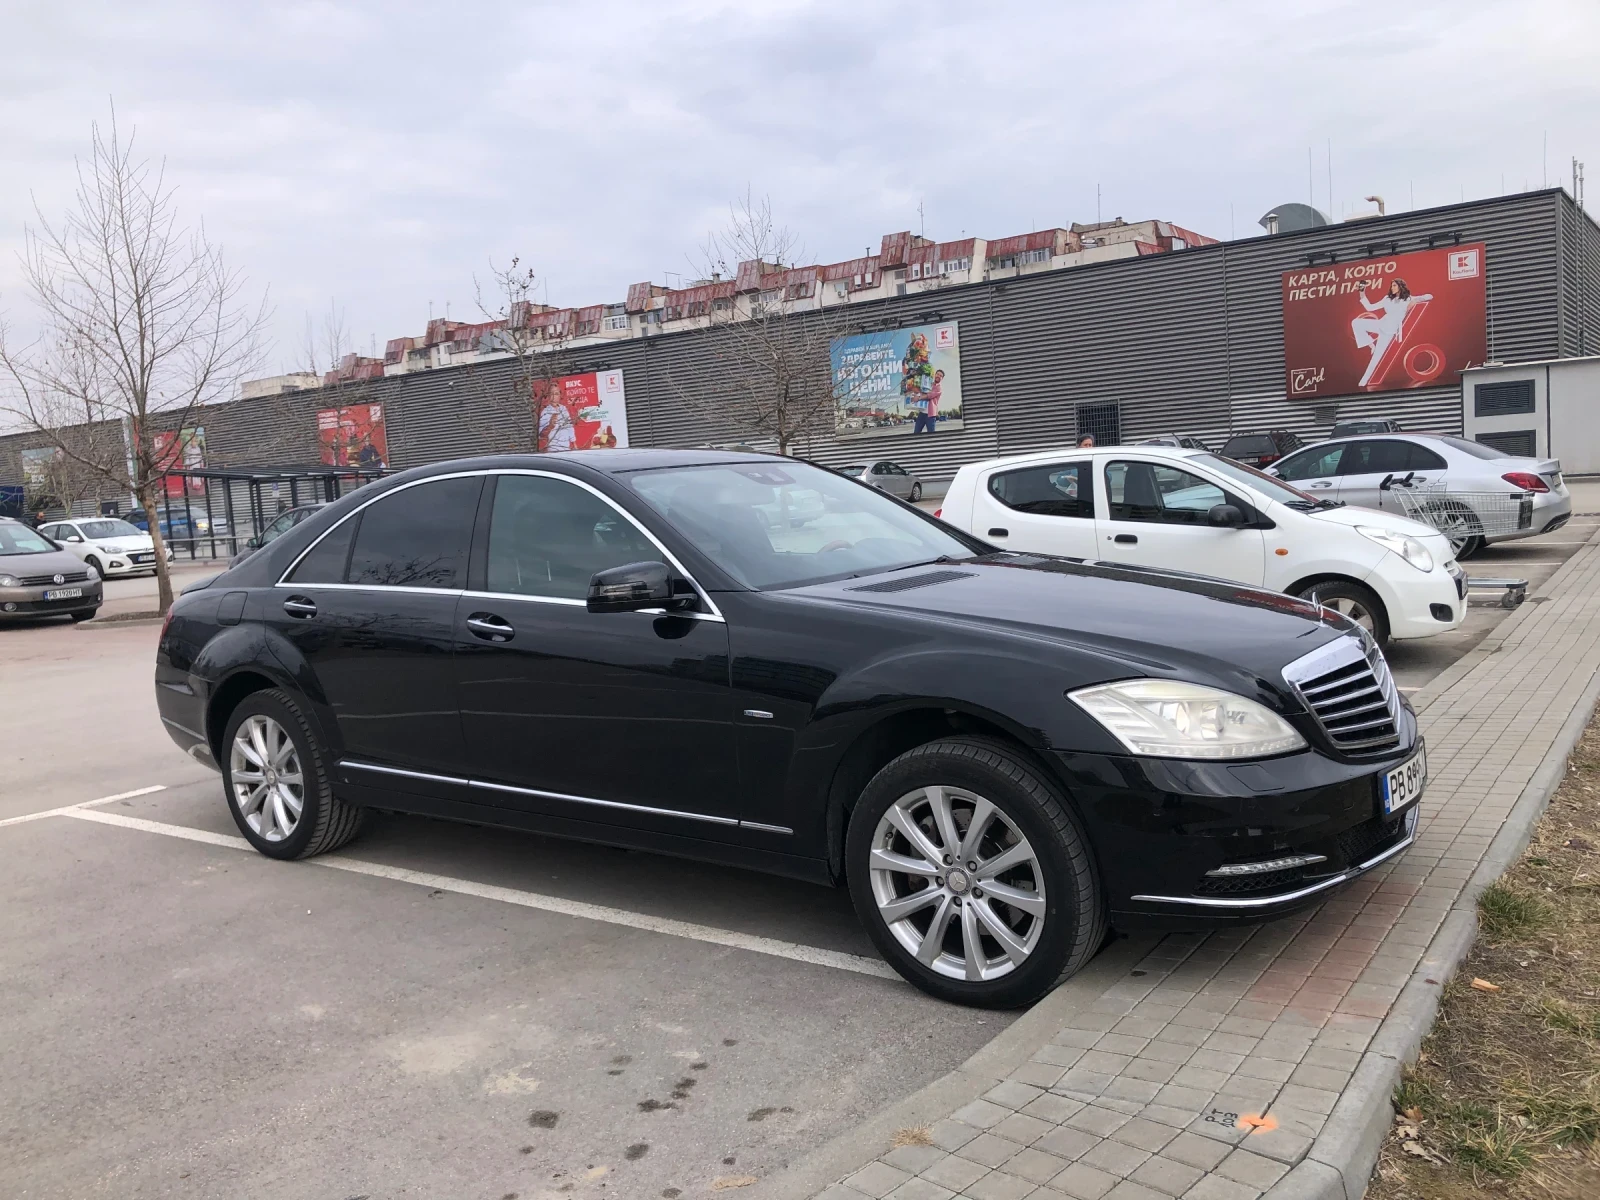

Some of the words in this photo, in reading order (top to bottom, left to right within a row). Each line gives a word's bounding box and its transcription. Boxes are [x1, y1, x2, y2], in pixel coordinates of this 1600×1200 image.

[1288, 270, 1340, 287] КАРТА,
[1344, 261, 1397, 279] КОЯТО
[1289, 285, 1337, 302] ПЕСТИ
[1340, 277, 1383, 295] ПАРИ
[838, 360, 903, 380] ИЗГОДНИ
[1294, 367, 1326, 391] Card
[849, 374, 892, 396] ЦЕНИ!
[1390, 771, 1406, 806] PB
